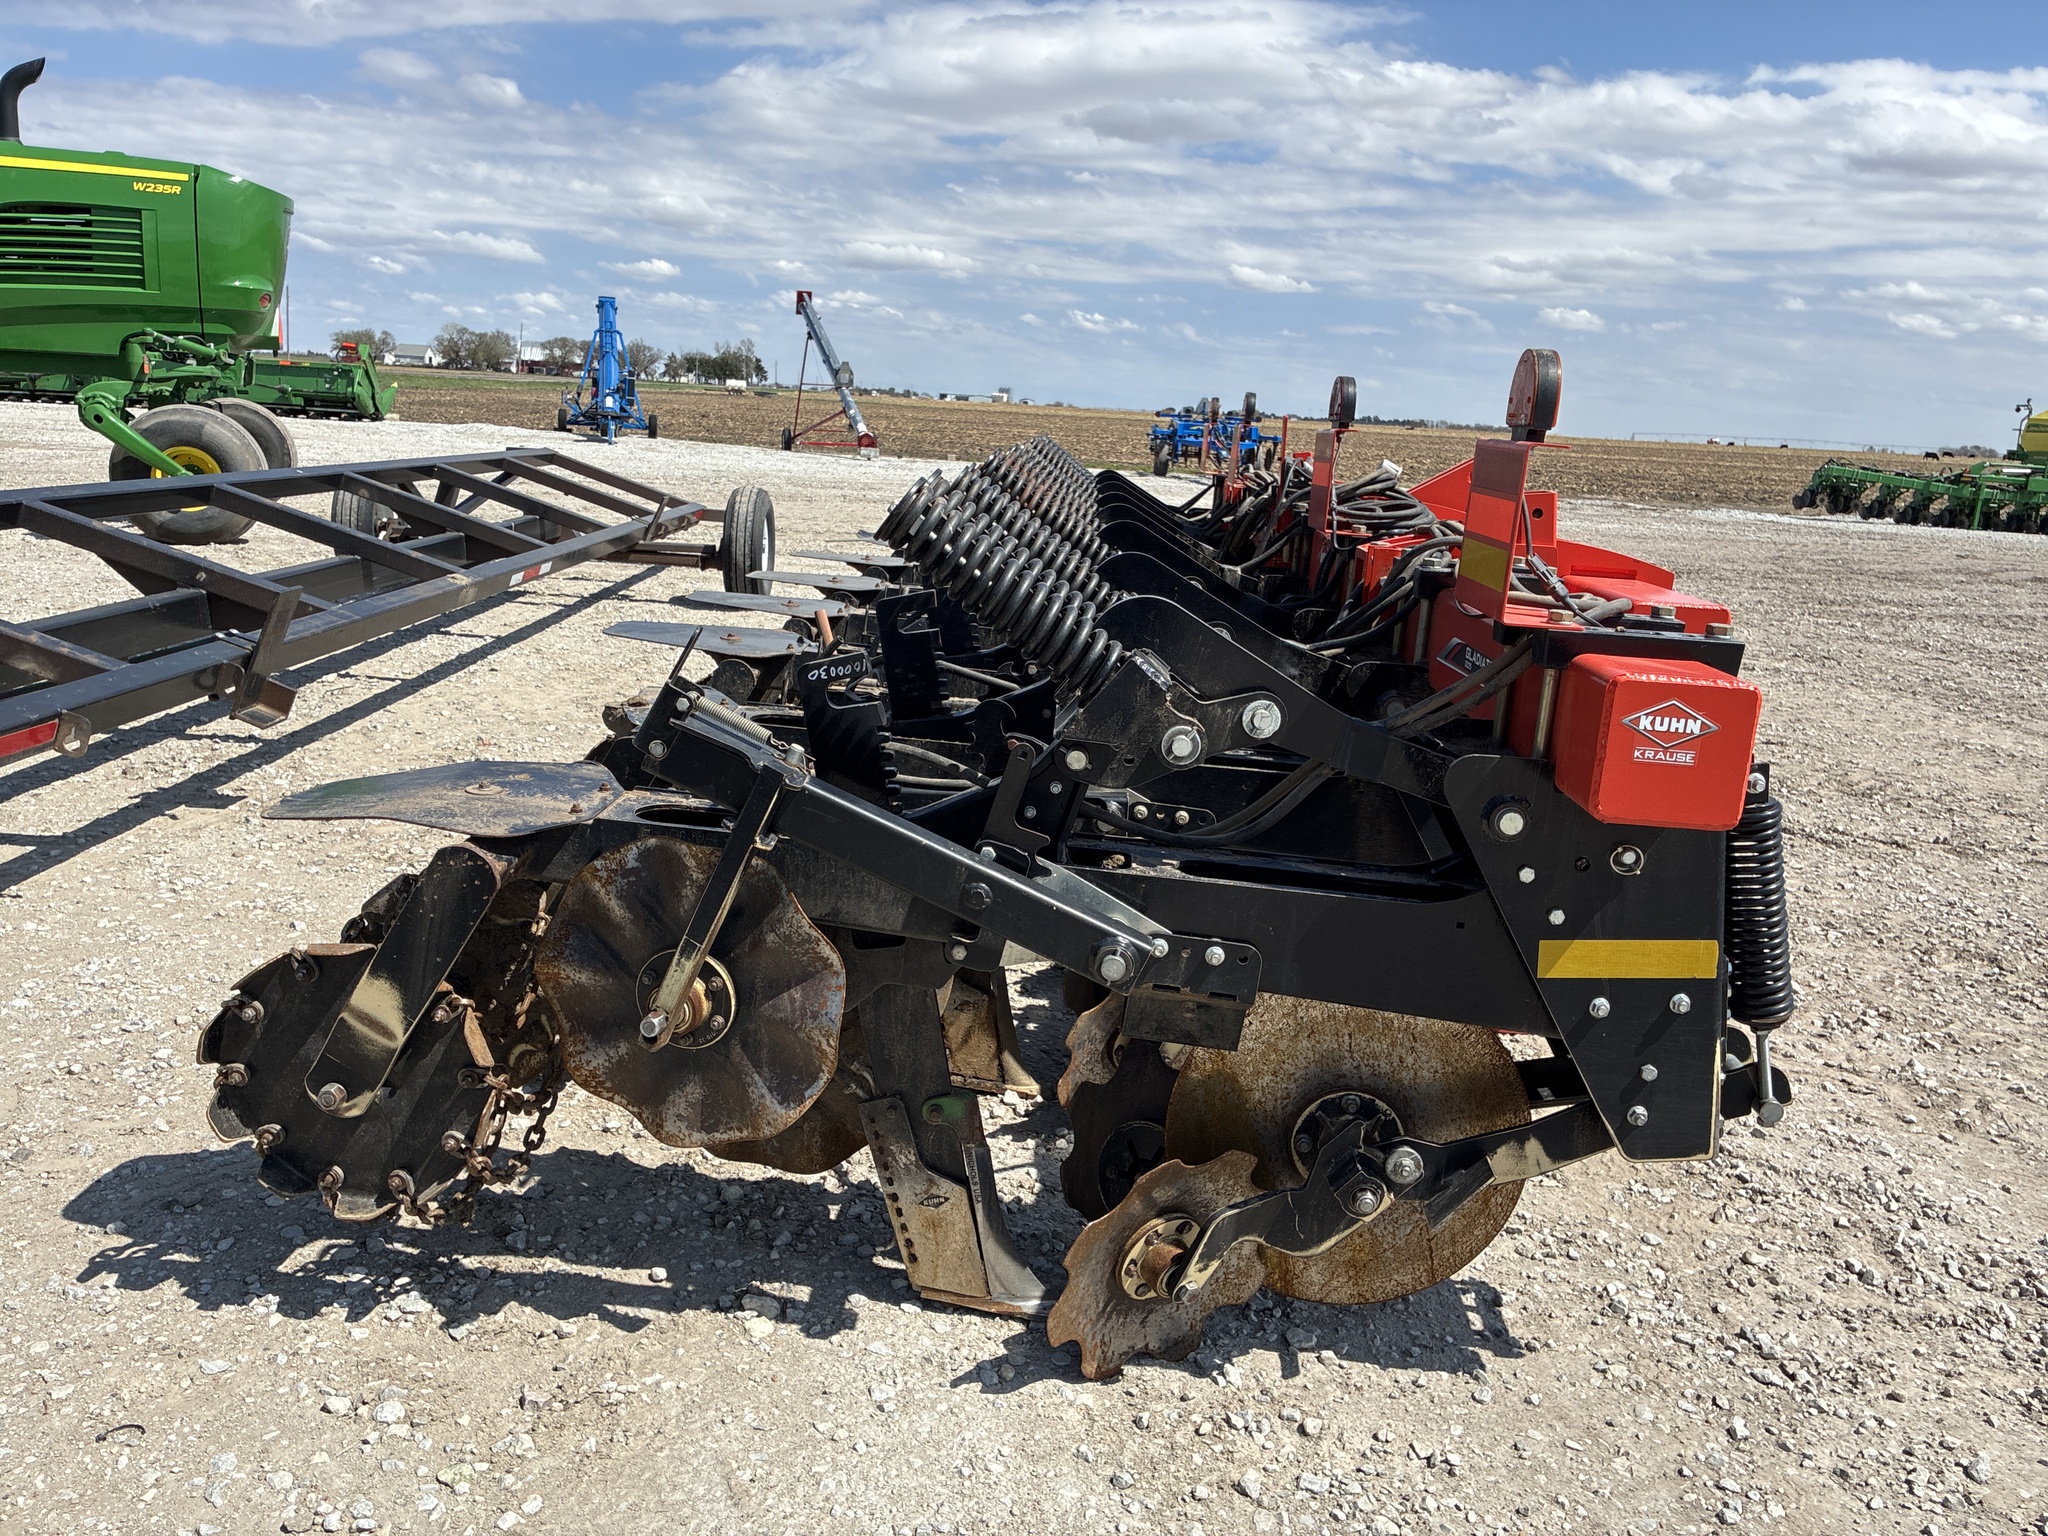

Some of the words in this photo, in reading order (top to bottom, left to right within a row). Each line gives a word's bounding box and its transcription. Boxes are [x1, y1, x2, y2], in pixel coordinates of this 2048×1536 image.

[133, 181, 182, 195] W235R
[807, 658, 866, 680] 1000030
[1638, 714, 1702, 734] KUHN
[1633, 749, 1696, 763] KRAUSE
[966, 1151, 979, 1187] NICHOLS
[923, 1192, 945, 1206] KUHN
[972, 1188, 982, 1205] USA
